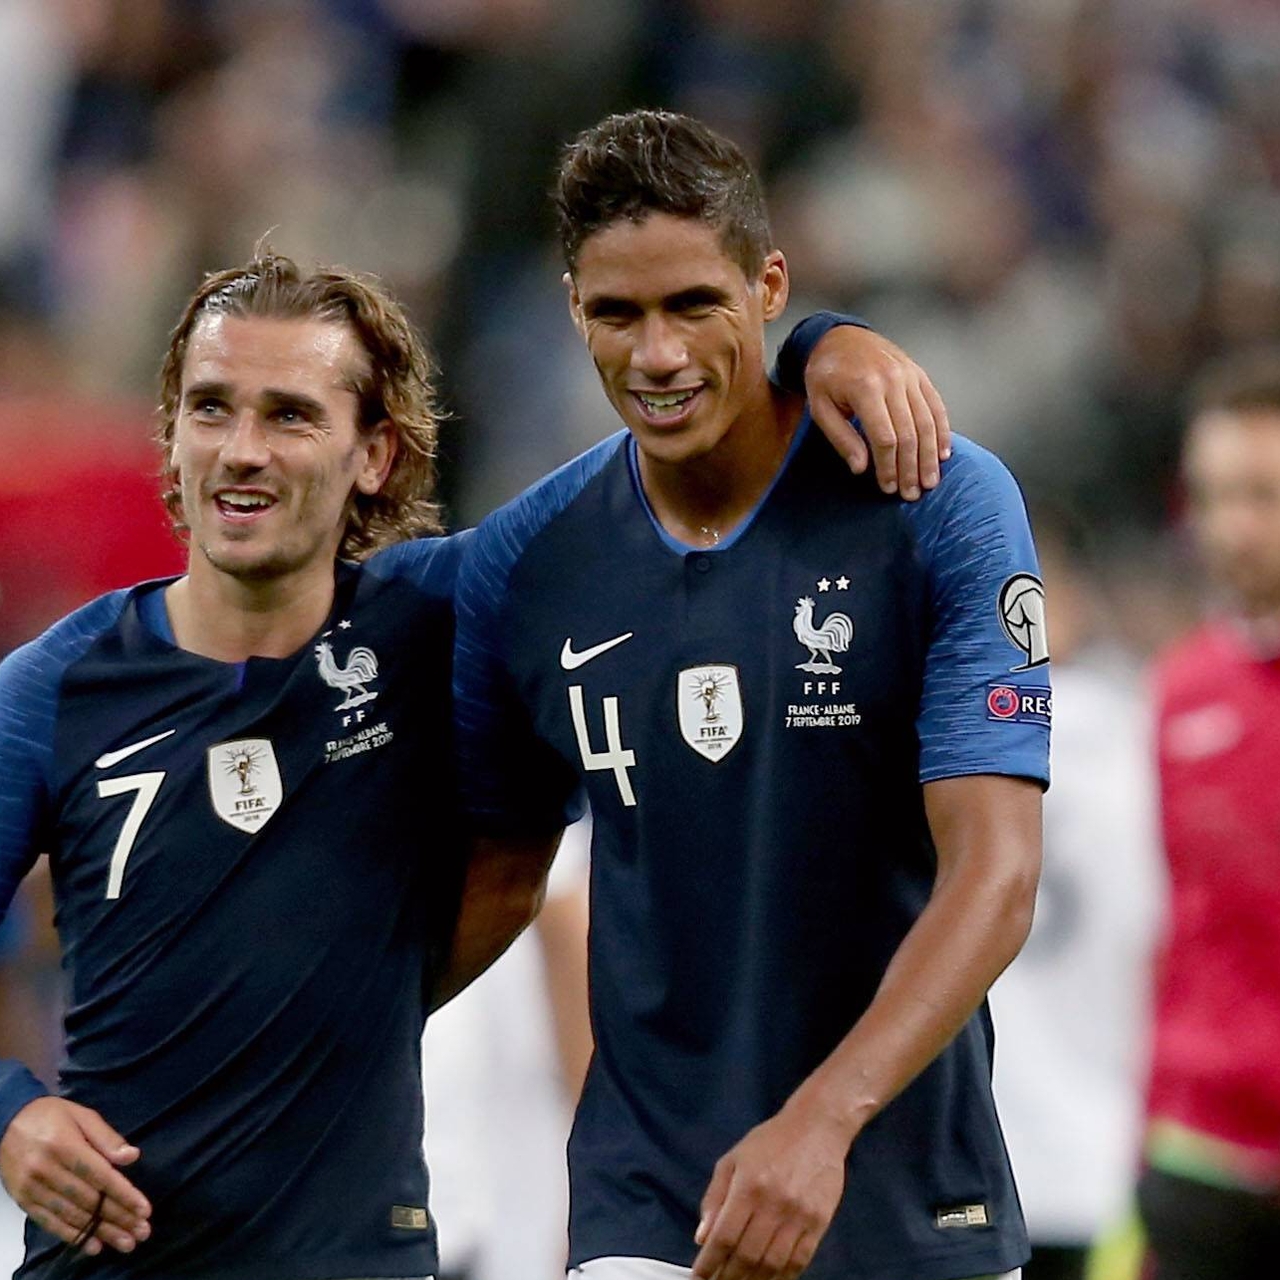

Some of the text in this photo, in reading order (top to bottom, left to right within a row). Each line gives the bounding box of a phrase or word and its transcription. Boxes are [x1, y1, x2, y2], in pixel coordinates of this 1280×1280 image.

[568, 685, 637, 806] 4
[838, 715, 861, 726] 2019
[97, 771, 166, 899] 7
